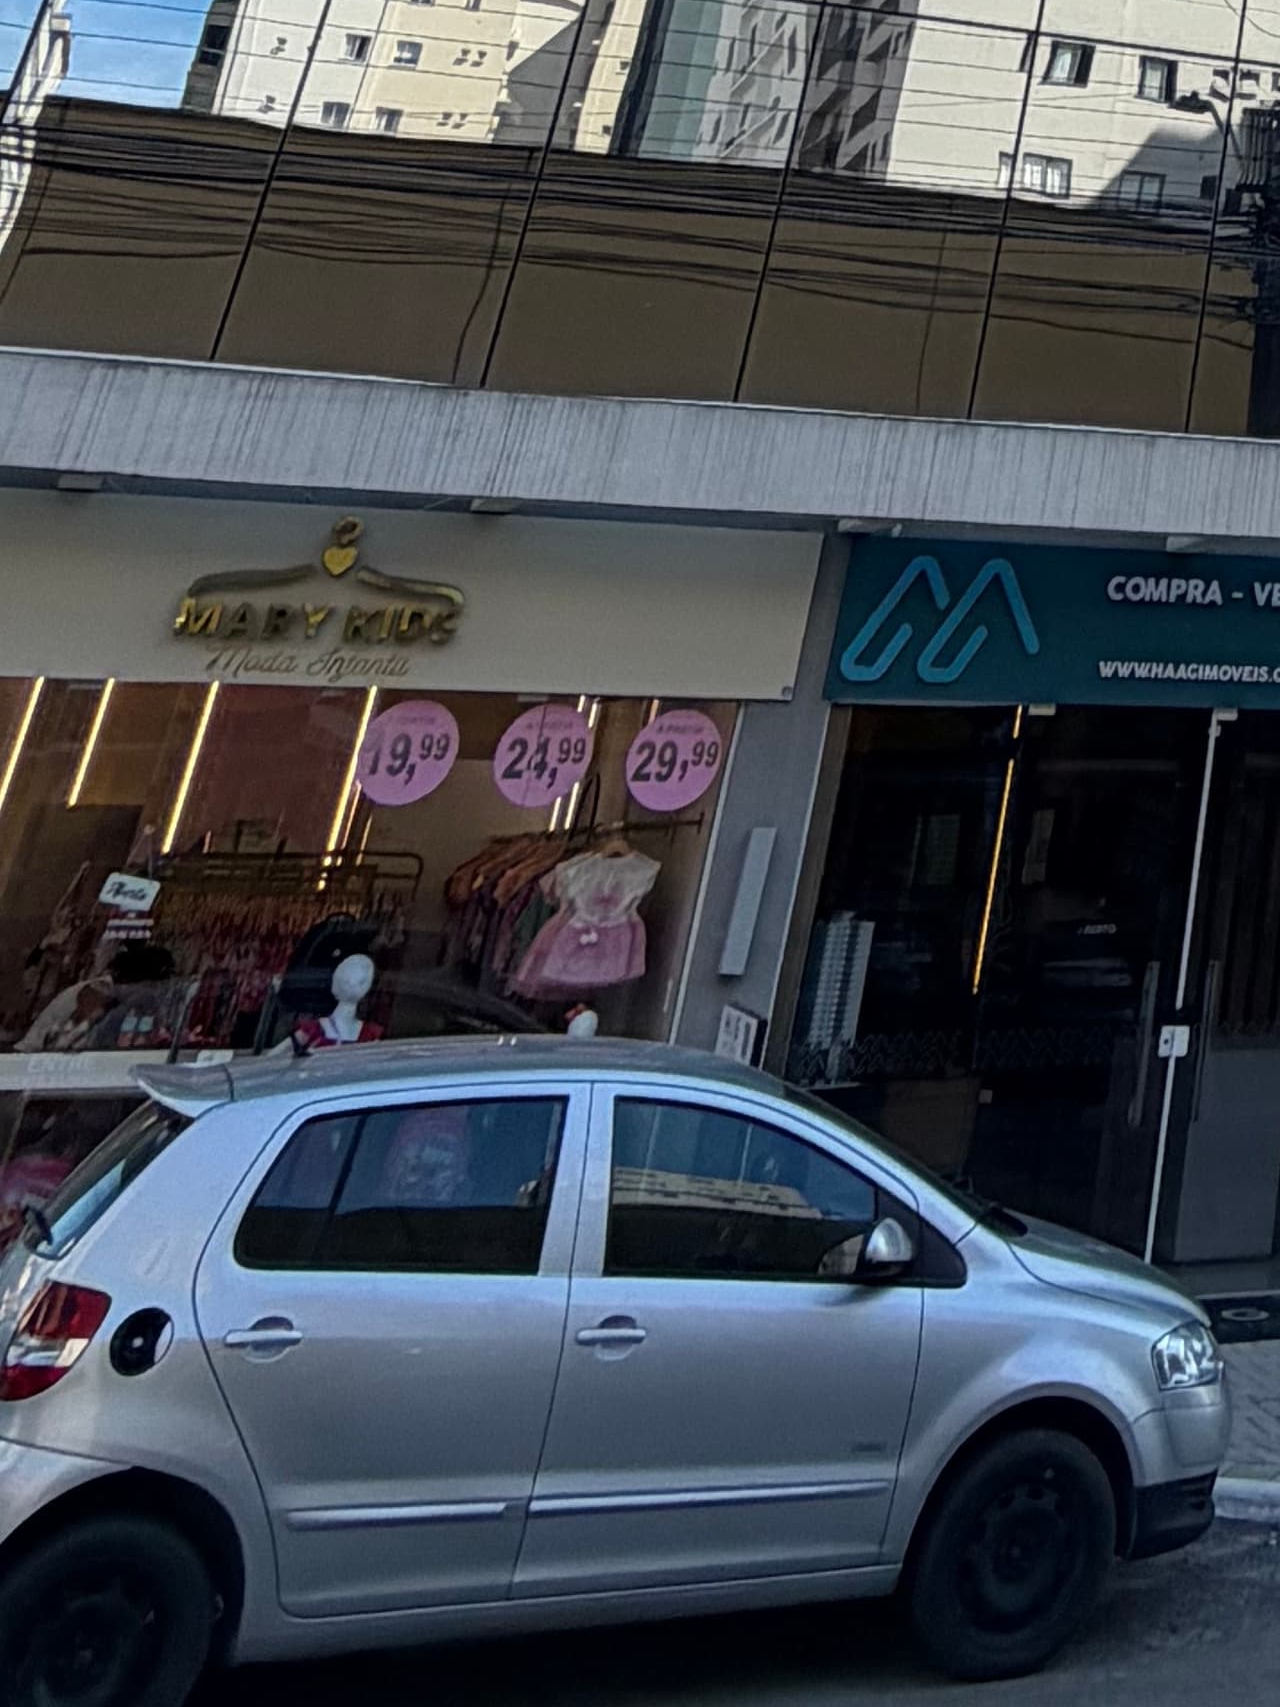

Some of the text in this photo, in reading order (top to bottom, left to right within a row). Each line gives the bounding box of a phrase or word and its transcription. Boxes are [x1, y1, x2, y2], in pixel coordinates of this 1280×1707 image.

[1107, 575, 1223, 606] COMPRA
[342, 601, 461, 645] KIDS
[631, 739, 720, 783] 29,99
